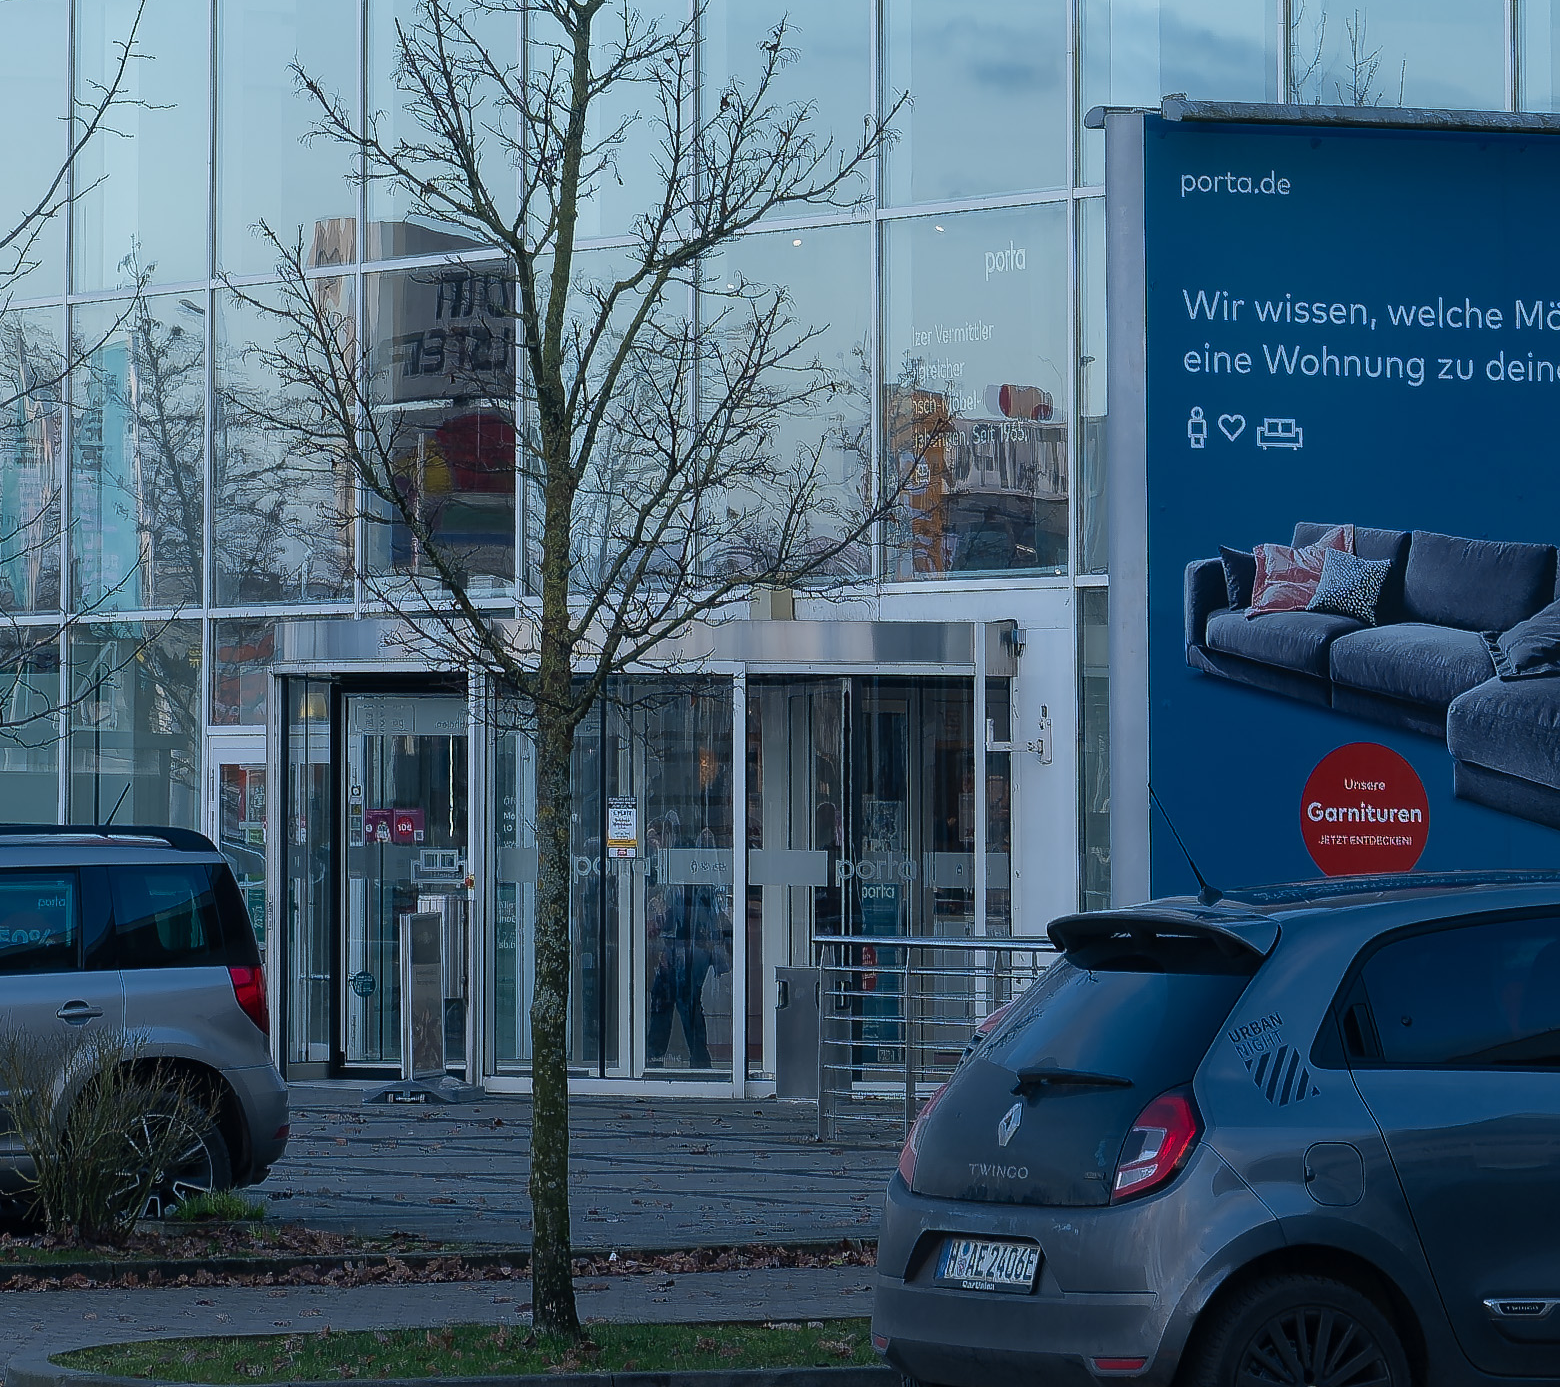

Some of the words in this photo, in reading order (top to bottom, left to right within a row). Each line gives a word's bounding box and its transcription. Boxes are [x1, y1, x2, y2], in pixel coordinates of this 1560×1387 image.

[1181, 170, 1291, 197] porta.de
[984, 240, 1027, 282] porta
[1183, 289, 1244, 321] Wir
[1255, 293, 1377, 330] wissen,
[1387, 296, 1504, 330] welche
[934, 320, 995, 344] Vermittler
[1183, 342, 1252, 373] eine
[1262, 344, 1425, 387] Wohnung
[1437, 358, 1474, 380] zu
[1344, 777, 1386, 791] Unsere
[1307, 801, 1423, 823] Garnituren
[1319, 834, 1348, 845] JETZT
[1349, 834, 1413, 846] ENTDECKEN!
[835, 849, 918, 888] porta
[1227, 1011, 1283, 1043] URBAN
[1235, 1029, 1282, 1060] NIGHT
[969, 1163, 1029, 1179] TWINGO
